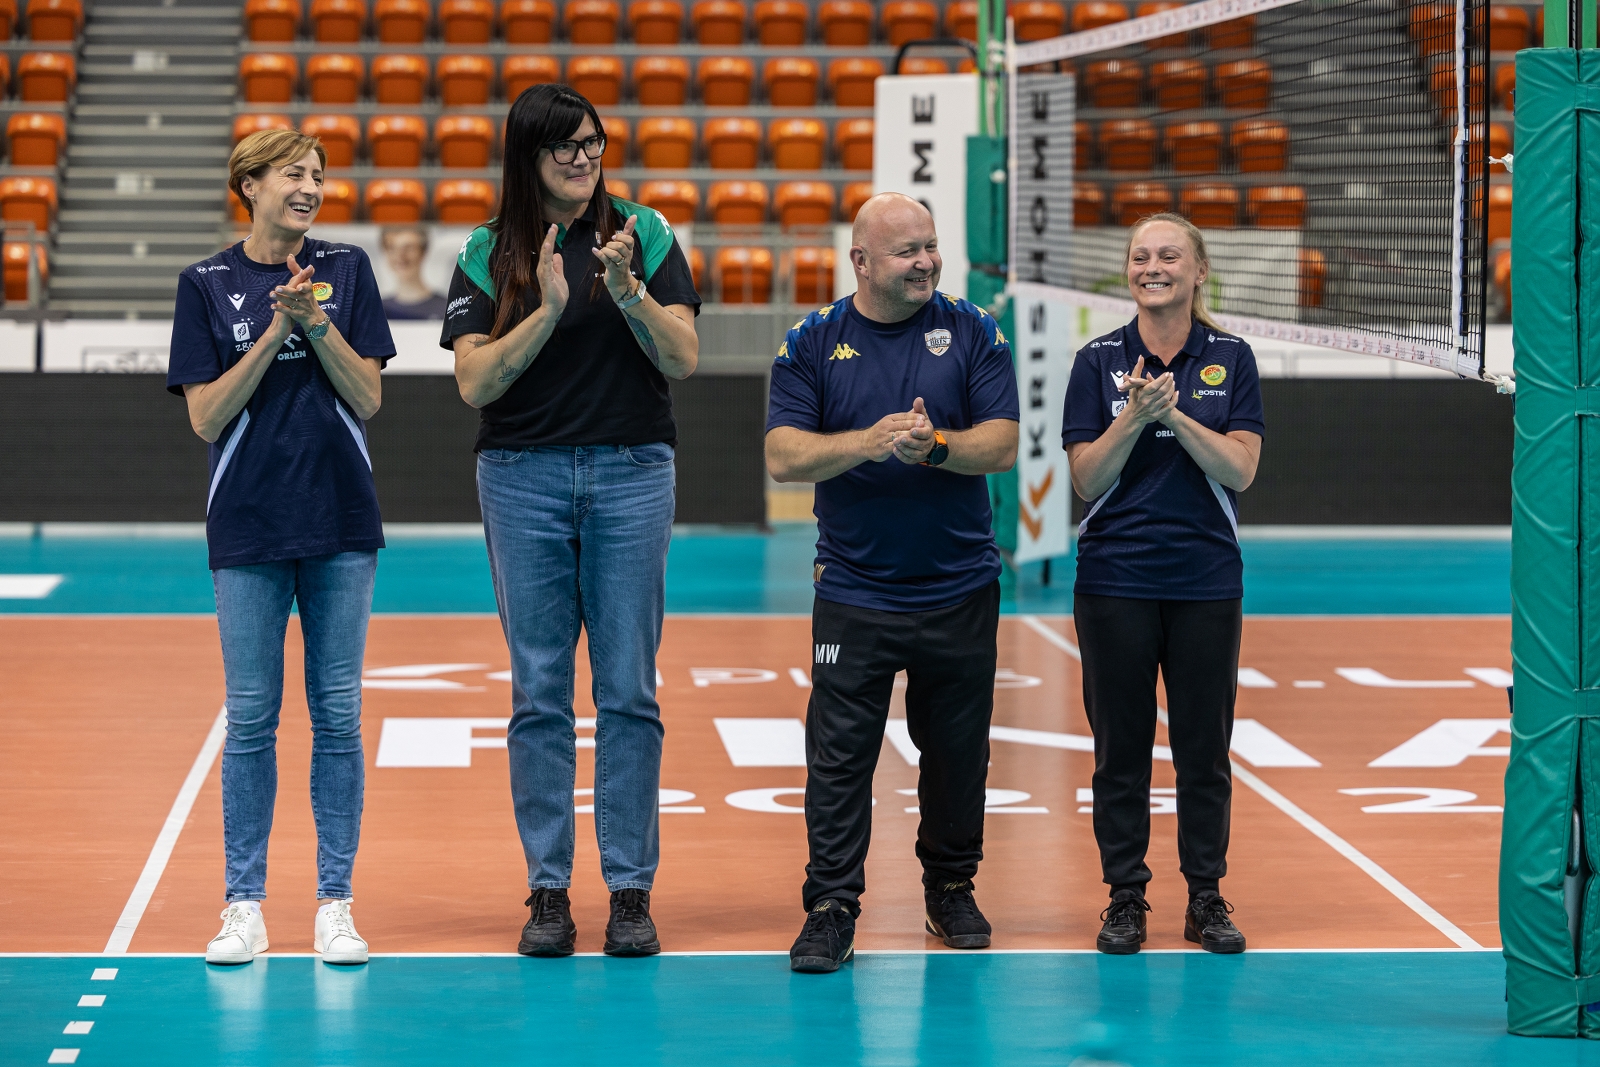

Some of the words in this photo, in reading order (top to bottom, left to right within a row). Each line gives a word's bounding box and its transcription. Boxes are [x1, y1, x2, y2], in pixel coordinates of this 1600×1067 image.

[277, 350, 307, 361] ORLEN
[1155, 430, 1176, 438] ORLE
[815, 644, 841, 664] MW
